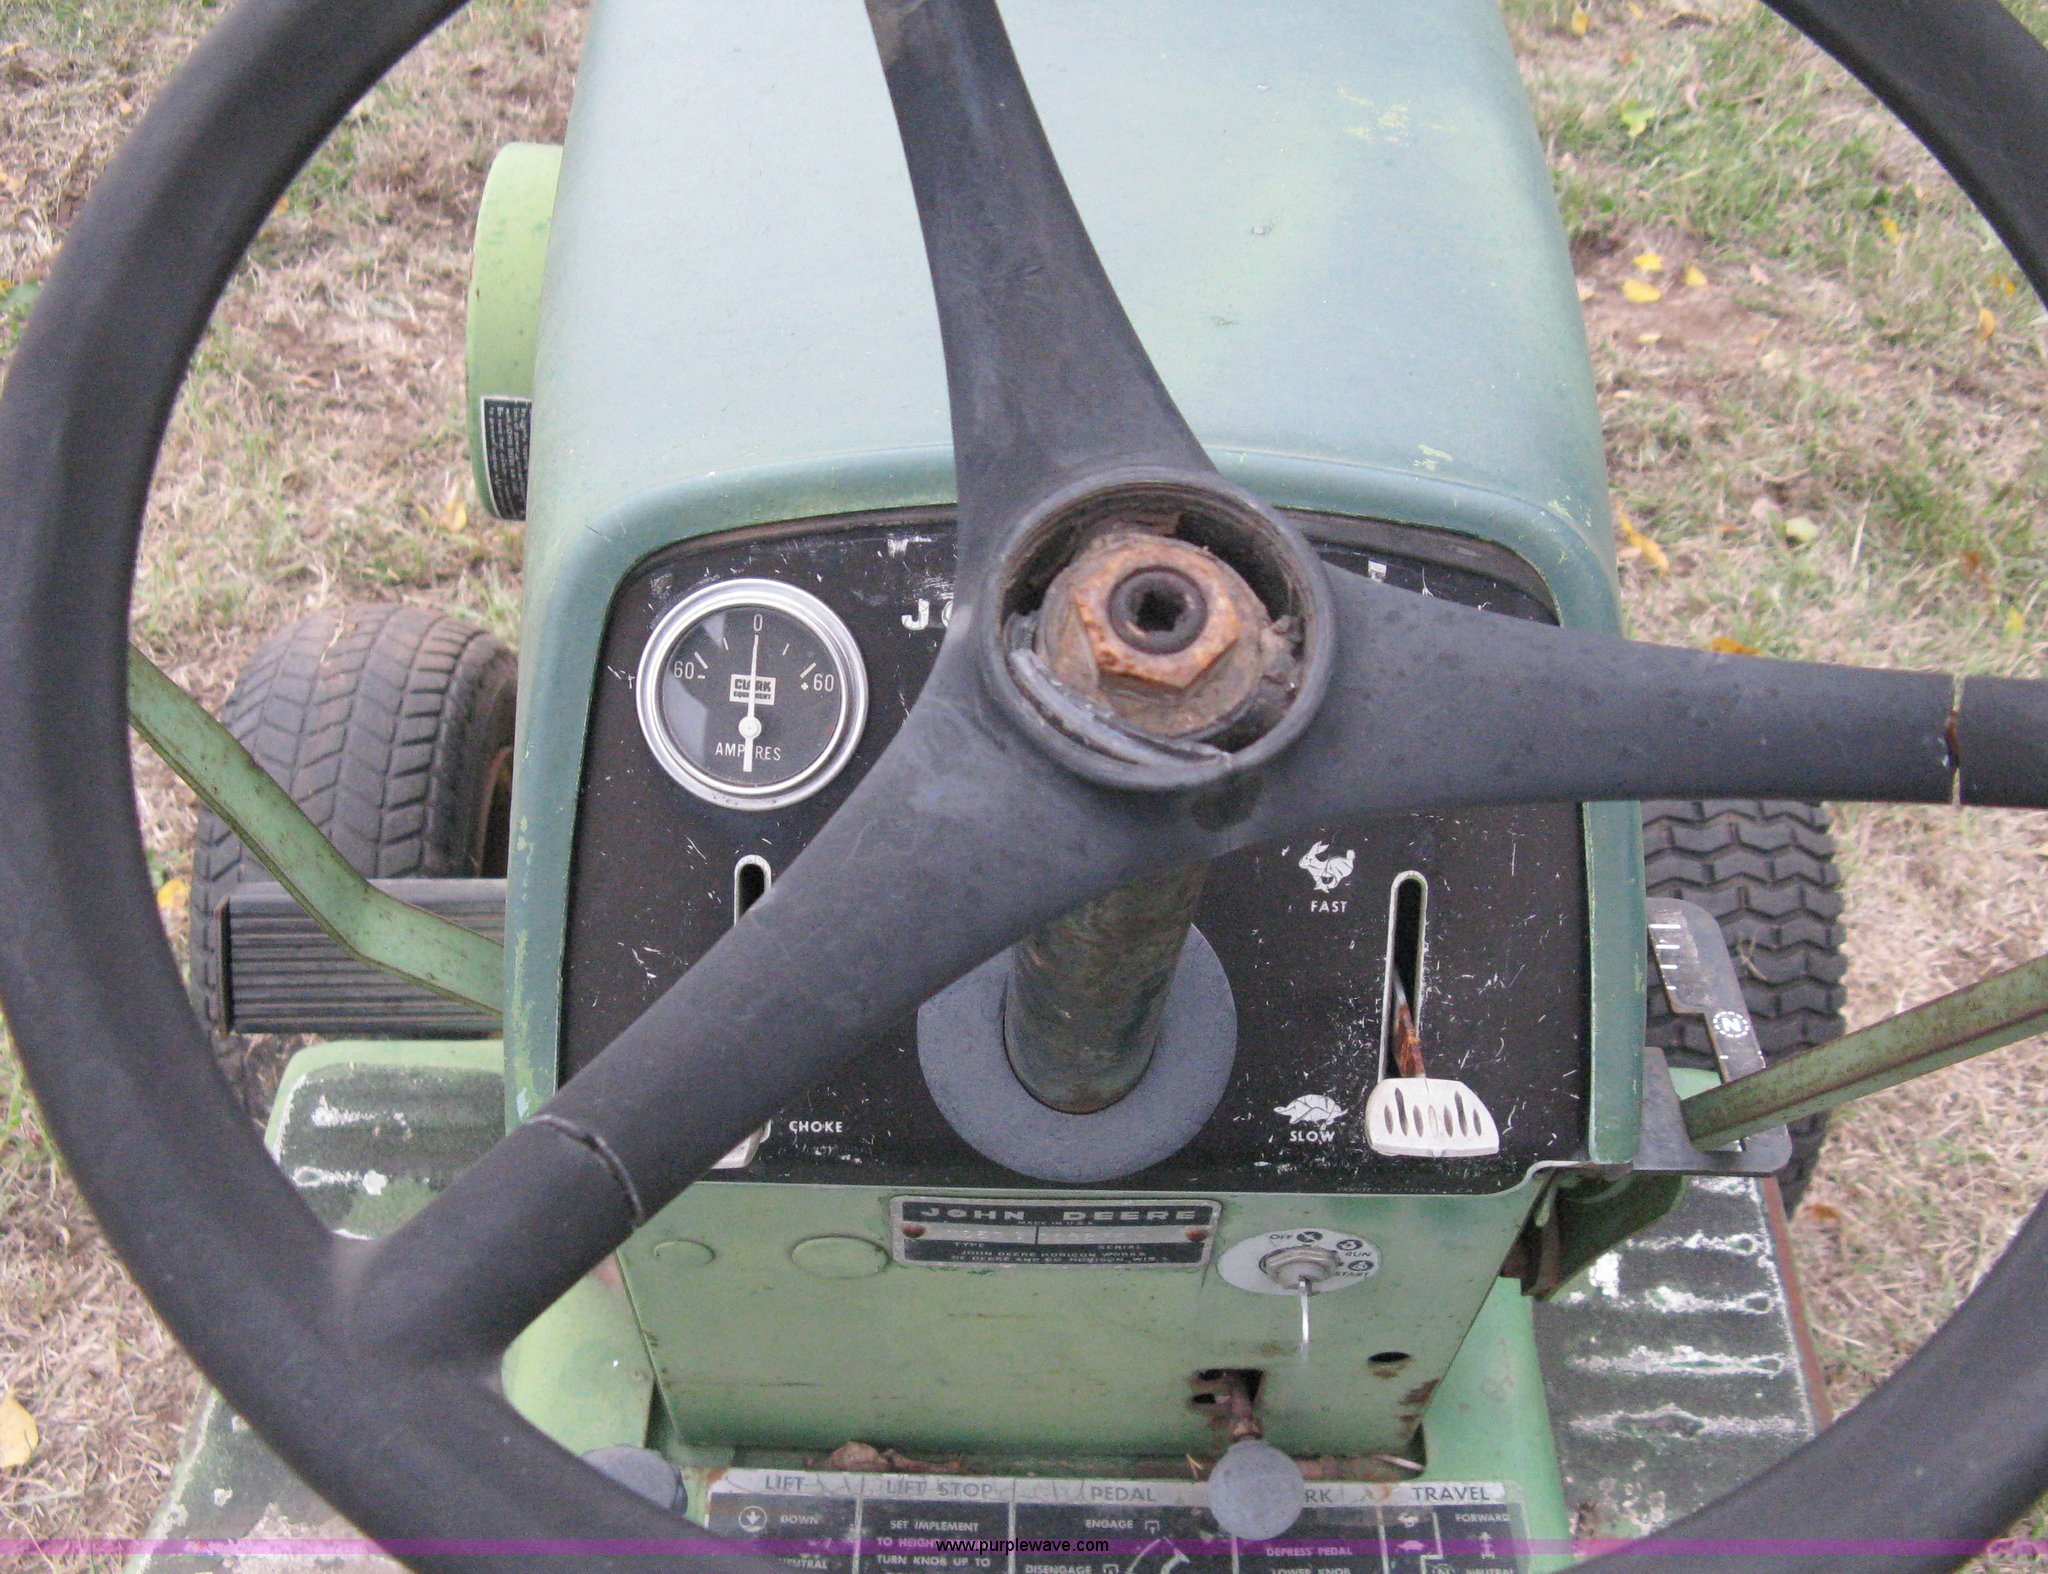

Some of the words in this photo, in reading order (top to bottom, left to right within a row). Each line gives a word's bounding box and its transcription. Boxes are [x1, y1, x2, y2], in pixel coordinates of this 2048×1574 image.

[753, 613, 764, 632] 0
[673, 661, 695, 680] 60
[813, 674, 834, 692] 60
[715, 742, 781, 761] AMPRES
[1310, 900, 1348, 913] FAST
[1720, 1017, 1742, 1032] N
[788, 1120, 843, 1133] CHOKE
[1289, 1130, 1335, 1142] SLOW
[920, 1207, 1025, 1220] JOHN
[1062, 1210, 1196, 1221] DEERE
[765, 1475, 805, 1490] LIFT
[885, 1479, 927, 1495] LIFT
[937, 1481, 992, 1498] STOP
[1090, 1486, 1158, 1502] PEDAL
[1412, 1486, 1490, 1501] TRAVEL
[781, 1514, 818, 1525] DOWN
[1085, 1518, 1134, 1530] ENGAGE
[1454, 1513, 1512, 1523] FORWARD
[890, 1519, 910, 1530] SET
[913, 1520, 980, 1533] IMPLEMENT
[877, 1537, 893, 1547] TO
[1317, 1546, 1353, 1556] PEDAL
[876, 1554, 907, 1565] TURN
[912, 1555, 948, 1567] KNOB
[952, 1556, 969, 1567] UP
[974, 1557, 992, 1568] TO
